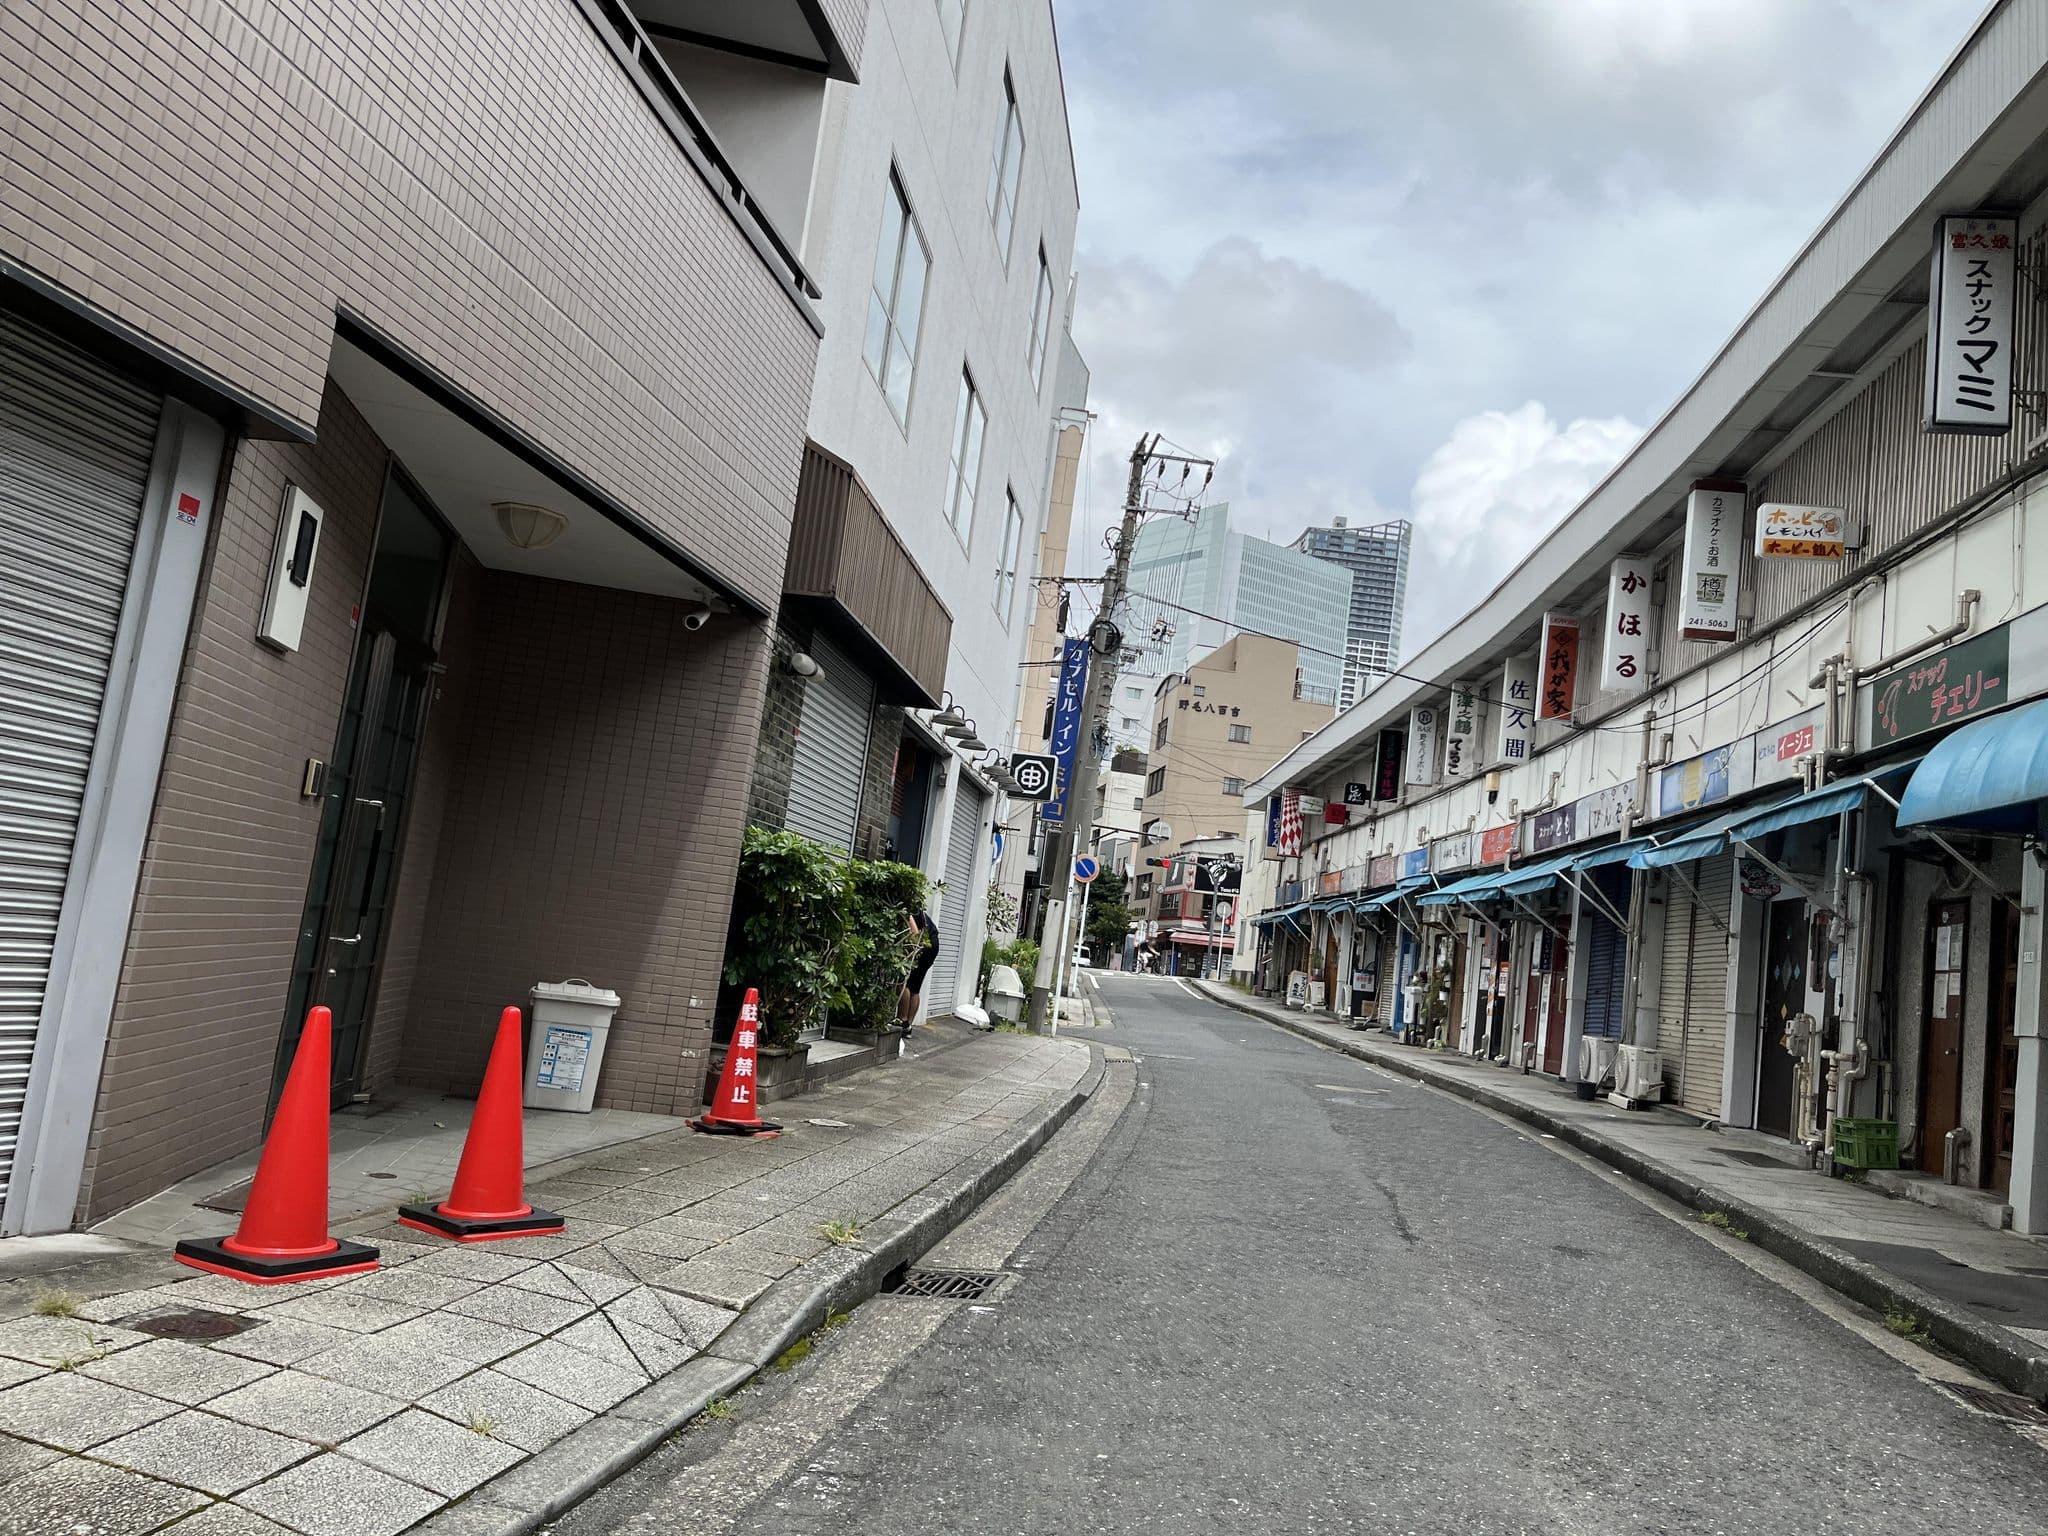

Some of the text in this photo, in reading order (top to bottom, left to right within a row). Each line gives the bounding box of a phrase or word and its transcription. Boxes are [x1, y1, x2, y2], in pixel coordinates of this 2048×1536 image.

[1616, 571, 1647, 678] かほる
[1689, 617, 1728, 628] 241-5063
[1908, 658, 1948, 694] スナック
[1931, 670, 2000, 724] チェリー
[1505, 680, 1530, 758] 佐久間
[731, 1003, 758, 1103] 駐車禁止
